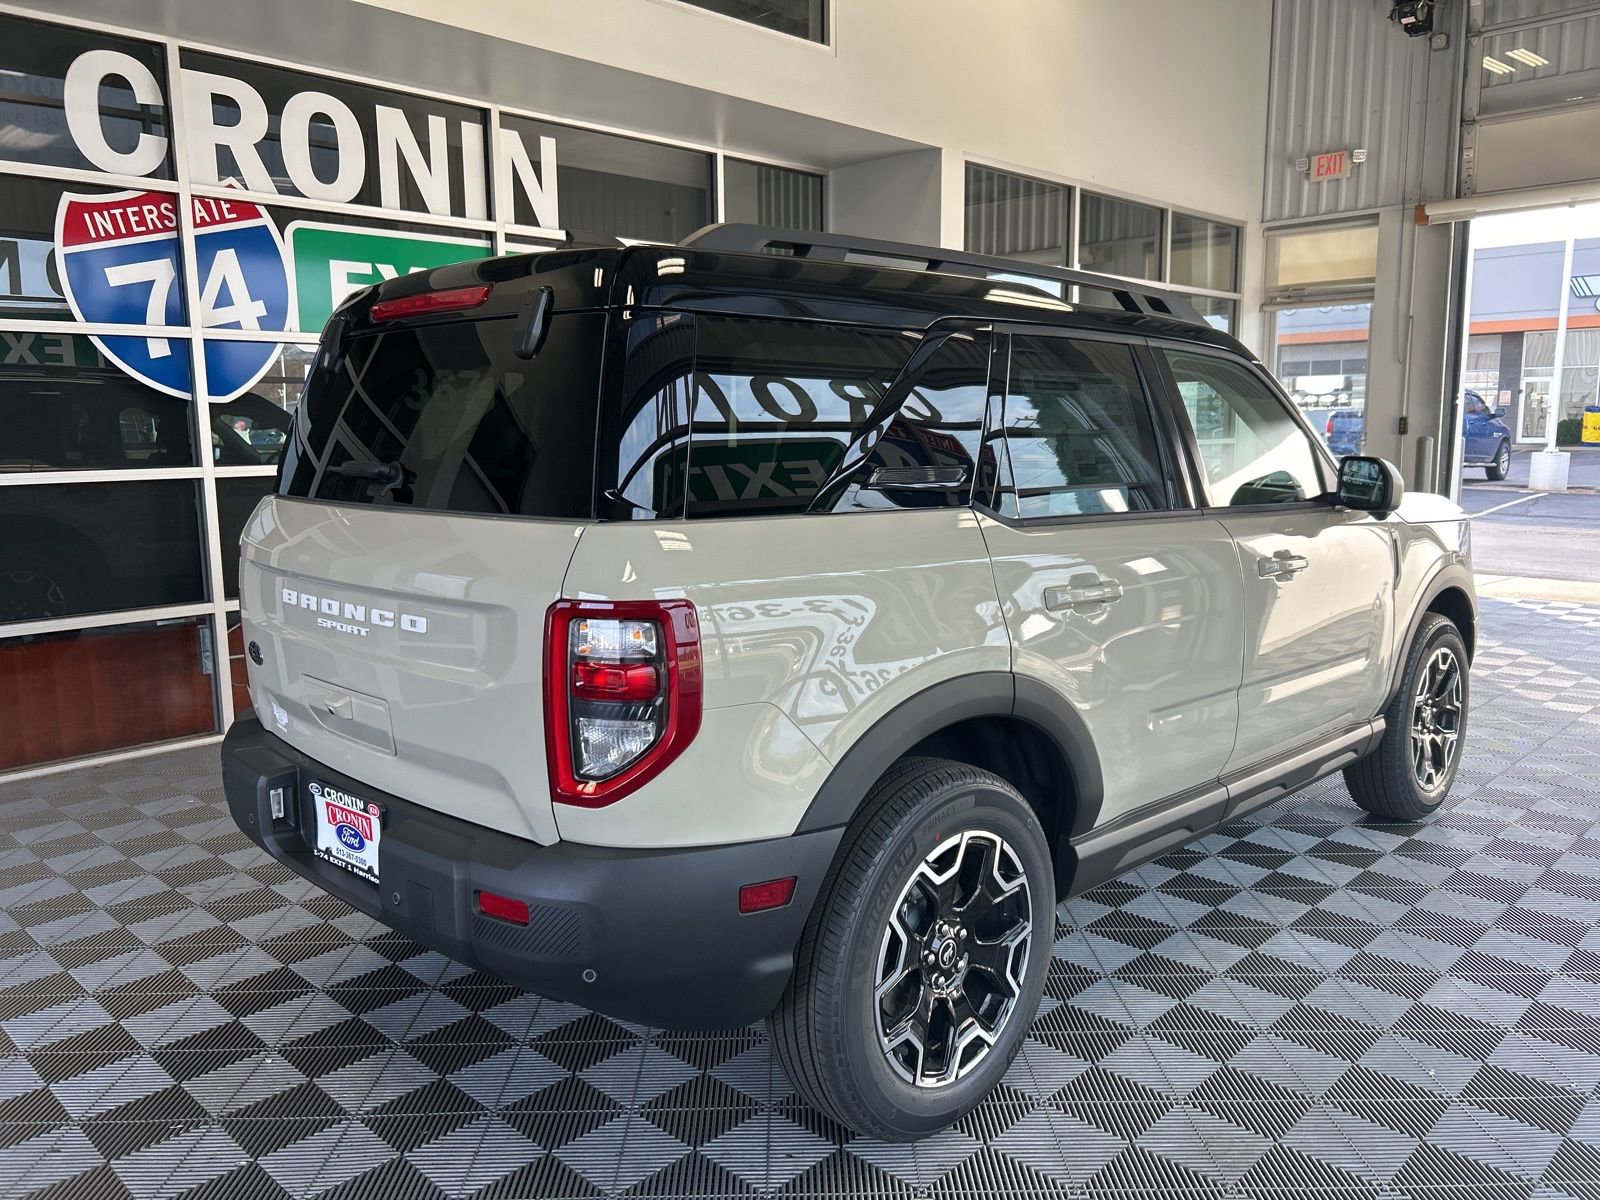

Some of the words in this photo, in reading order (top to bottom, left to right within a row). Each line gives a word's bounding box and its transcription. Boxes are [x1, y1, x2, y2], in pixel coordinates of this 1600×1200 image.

[64, 50, 559, 229] CRONIN
[1316, 151, 1345, 177] EXIT
[84, 199, 238, 239] INTERSATE
[103, 248, 267, 360] 74
[282, 588, 428, 634] BRONCO
[317, 617, 371, 637] SPORT
[324, 787, 364, 810] CRONIN
[328, 805, 371, 840] CRONIN
[341, 826, 360, 848] Ford
[330, 856, 347, 868] EXIT
[865, 840, 918, 941] MICHELIN
